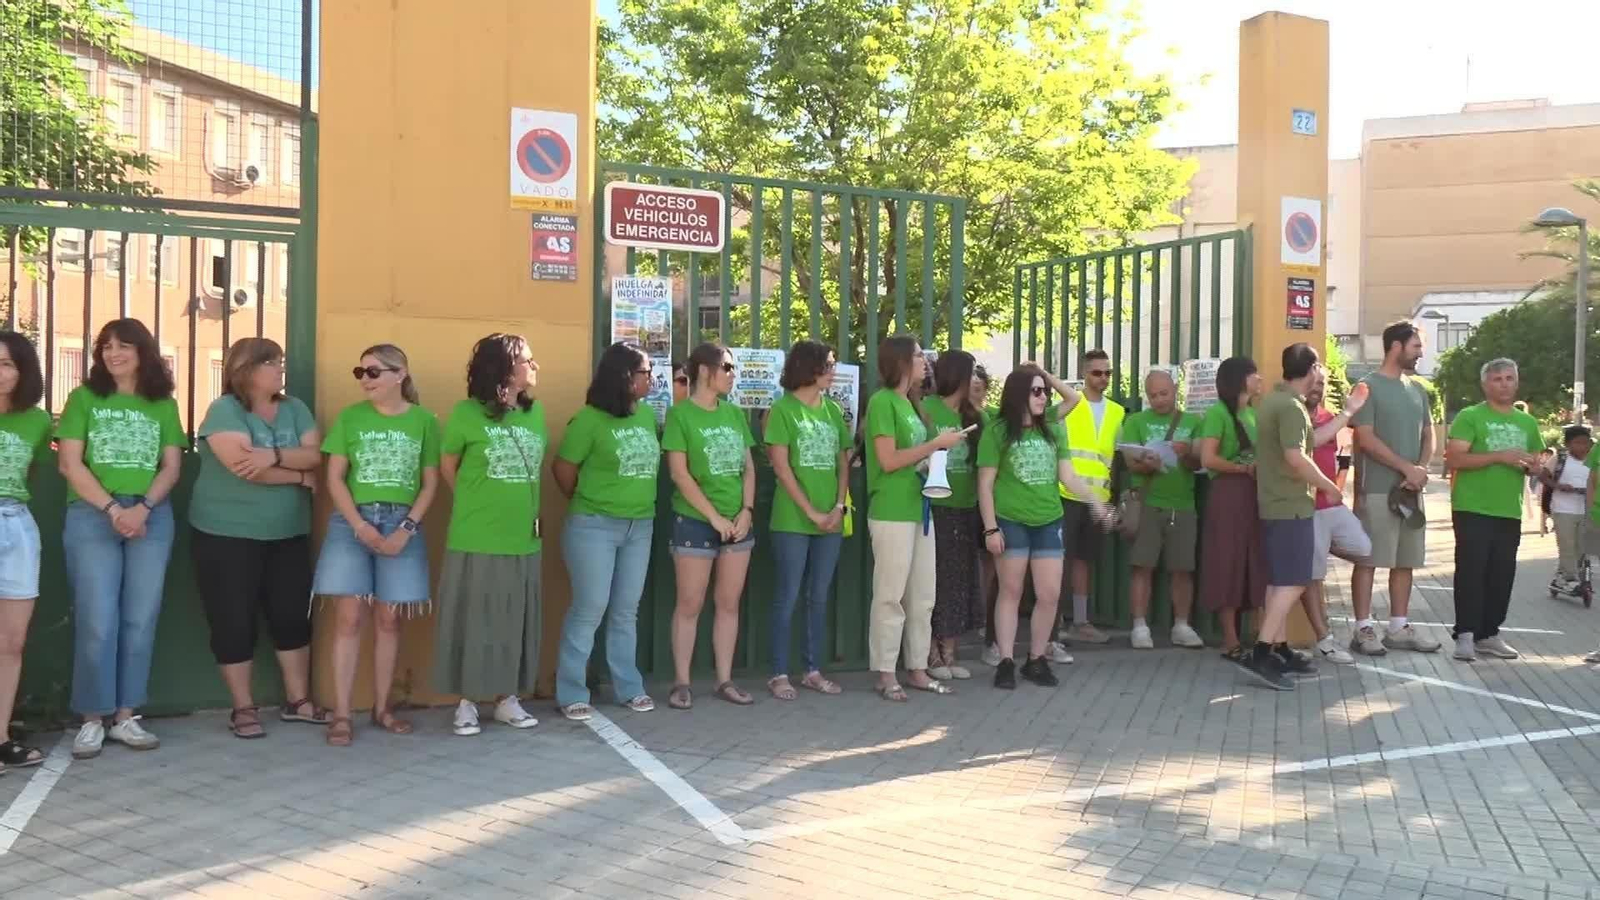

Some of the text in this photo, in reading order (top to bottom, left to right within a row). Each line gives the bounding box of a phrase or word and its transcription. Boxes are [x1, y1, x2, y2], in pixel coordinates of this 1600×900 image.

[520, 184, 569, 198] VADO
[635, 193, 697, 210] ACCESO
[540, 215, 570, 224] ALARMA
[624, 207, 708, 227] VEHICULOS
[533, 222, 575, 232] CONECTADA
[615, 223, 714, 244] EMERGENCIA
